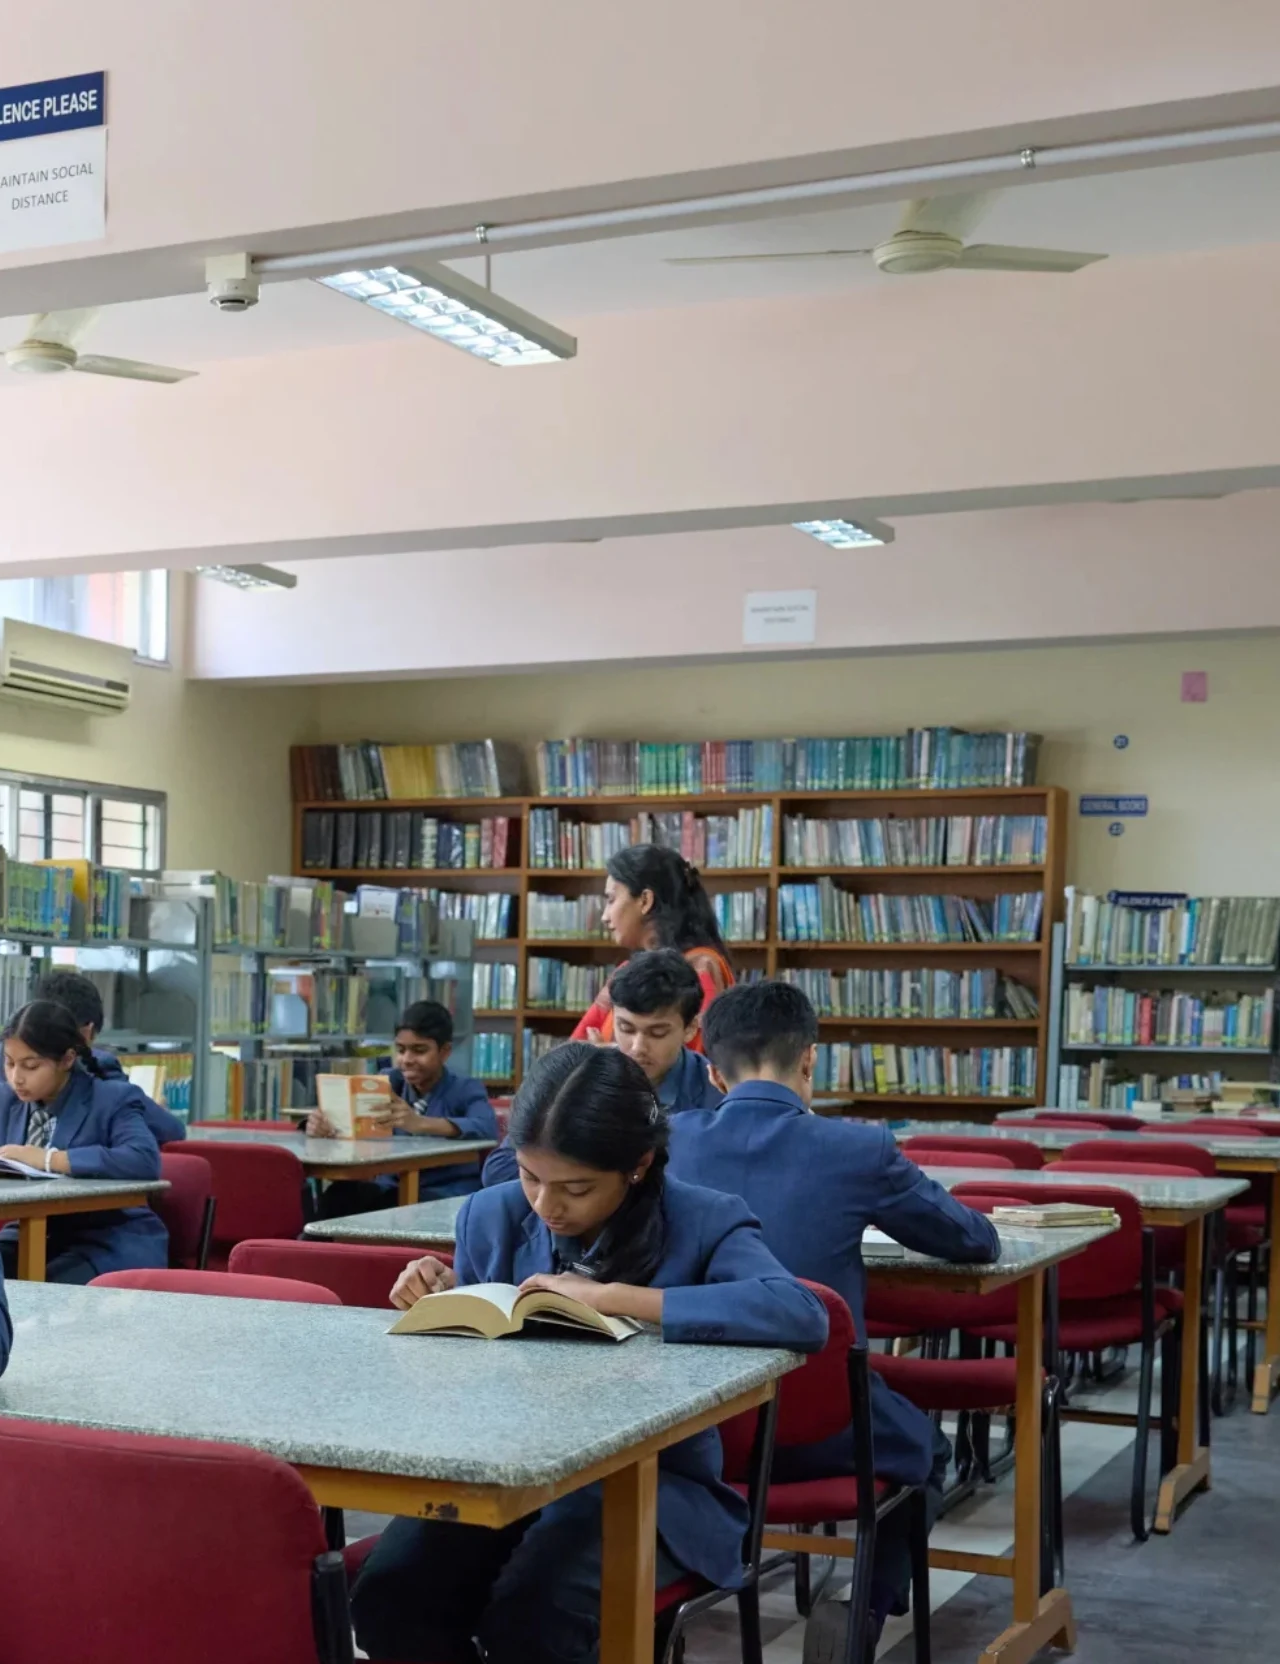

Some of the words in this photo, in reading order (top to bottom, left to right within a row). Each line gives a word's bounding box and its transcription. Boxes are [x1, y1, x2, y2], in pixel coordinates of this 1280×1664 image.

[43, 89, 97, 118] PLEASE
[52, 162, 94, 181] SOCIAL
[11, 190, 69, 210] DISTANCE
